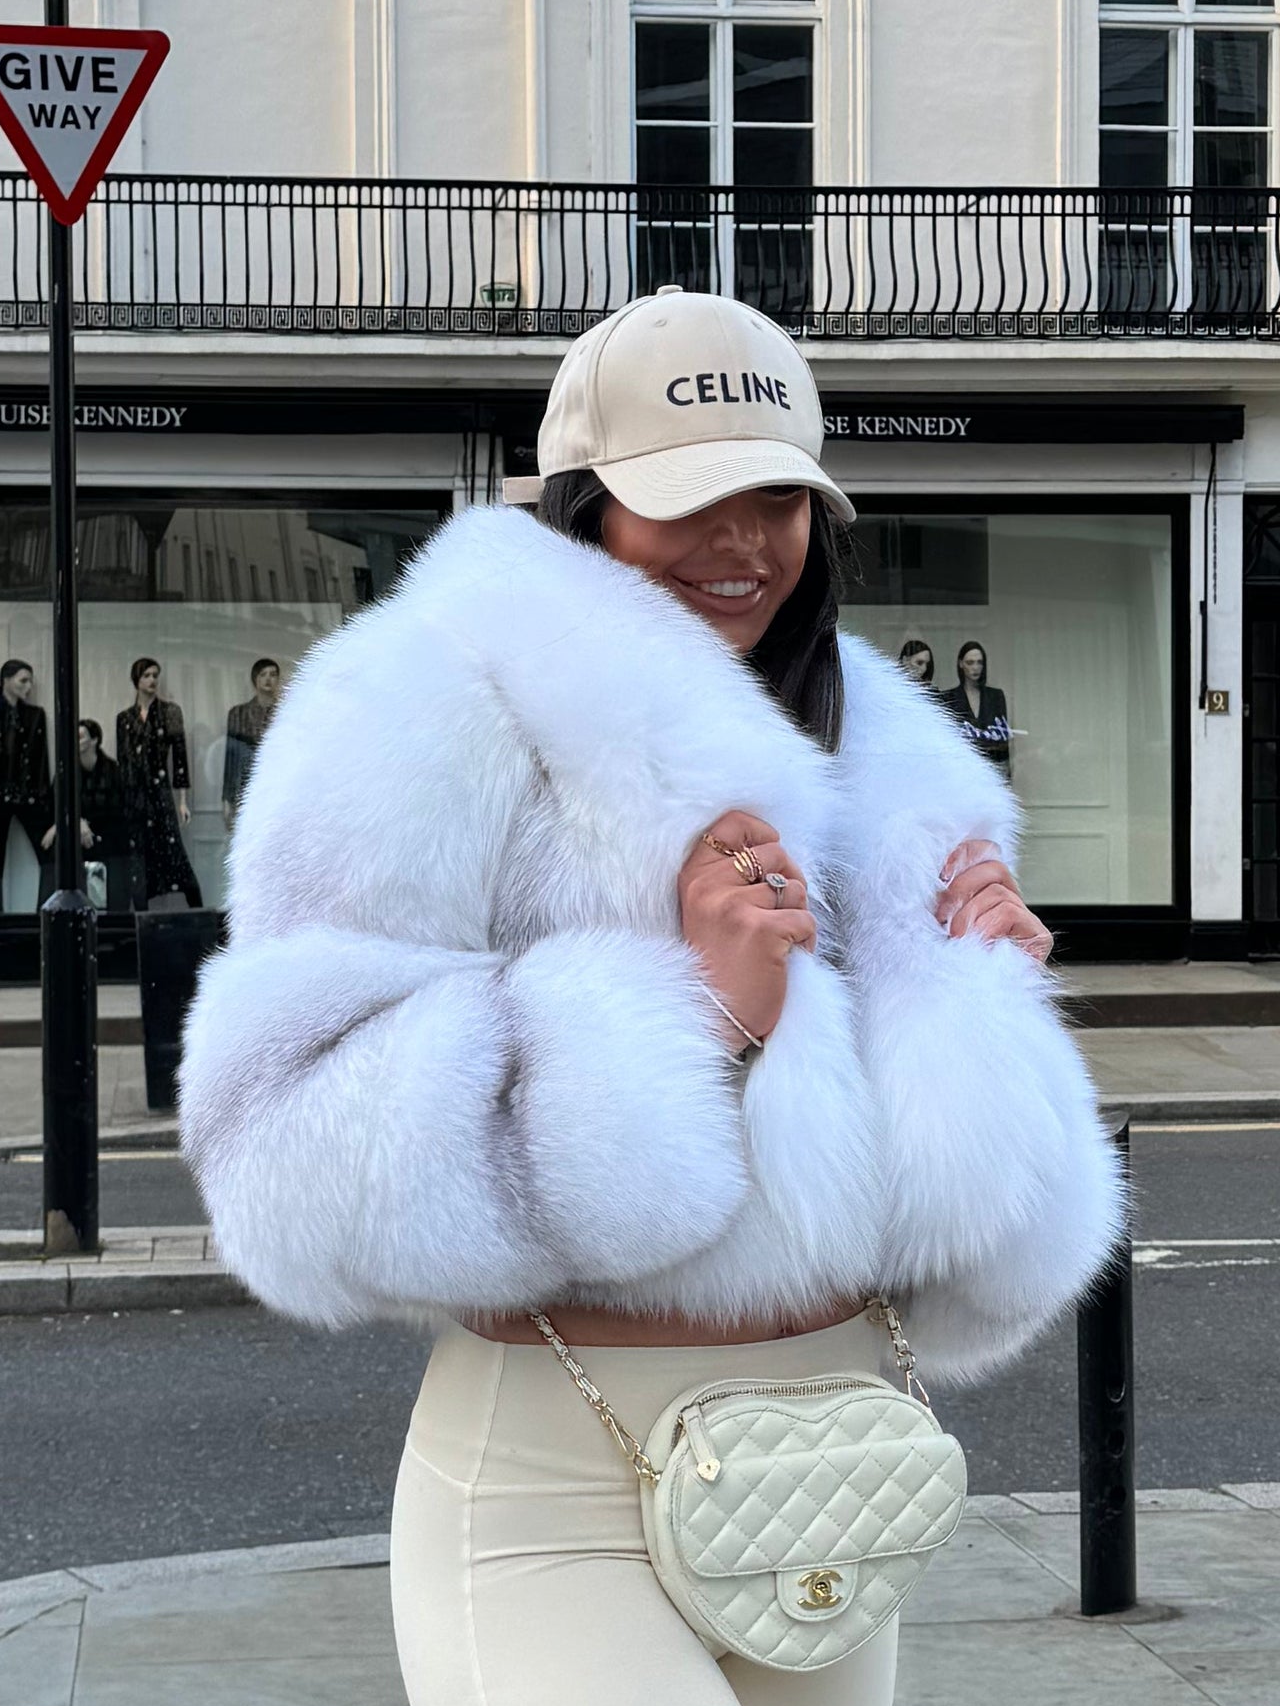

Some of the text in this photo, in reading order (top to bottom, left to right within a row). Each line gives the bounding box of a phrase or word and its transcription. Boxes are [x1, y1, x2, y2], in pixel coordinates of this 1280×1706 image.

[28, 103, 102, 130] WAY
[666, 372, 792, 411] CELINE
[857, 416, 971, 436] KENNEDY
